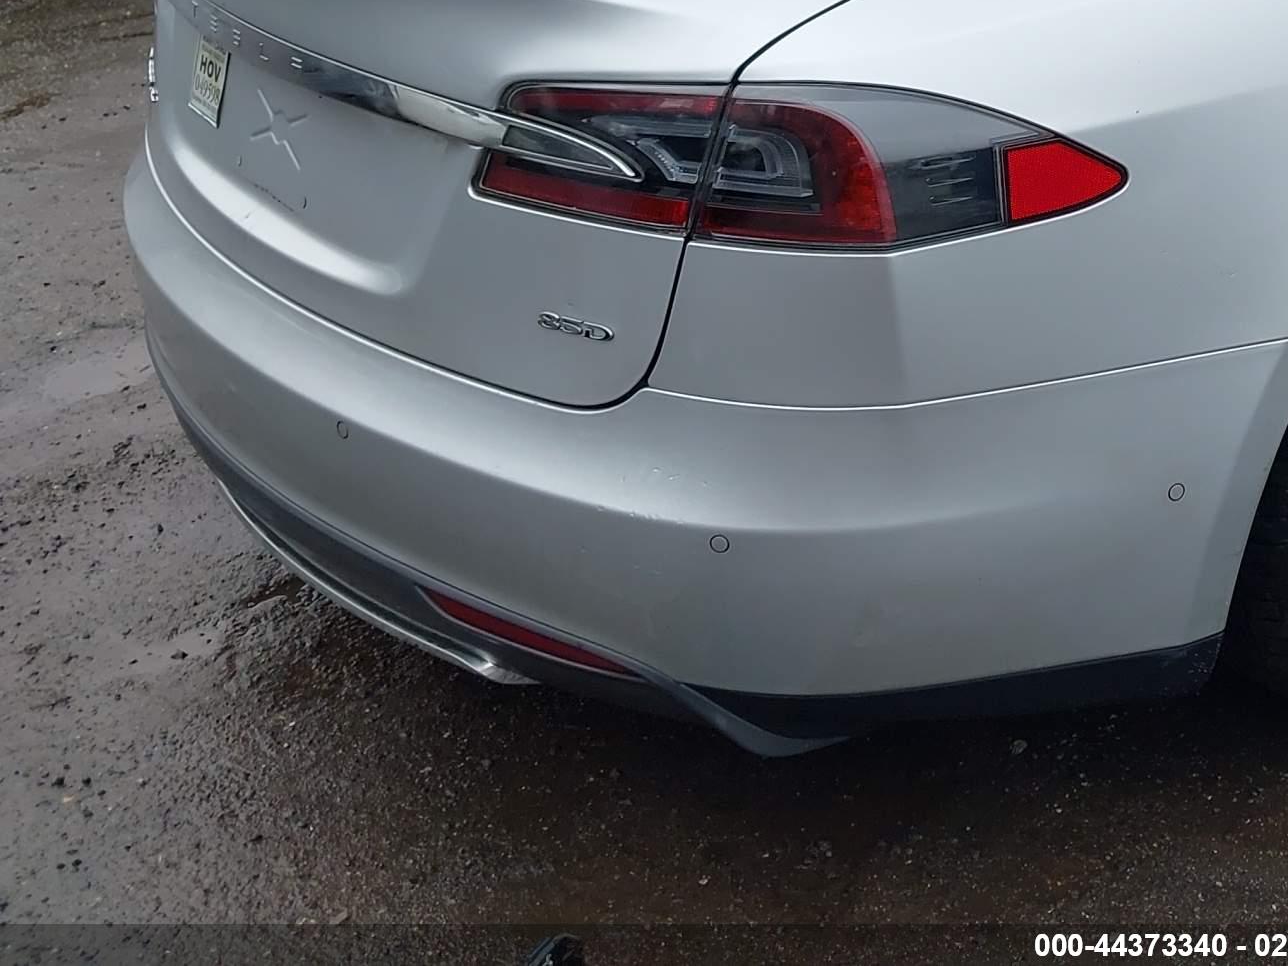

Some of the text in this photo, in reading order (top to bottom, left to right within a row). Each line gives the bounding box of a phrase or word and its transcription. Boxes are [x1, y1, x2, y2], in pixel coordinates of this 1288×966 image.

[191, 0, 303, 69] TESLA
[199, 54, 222, 83] HOV
[537, 311, 615, 341] 85D
